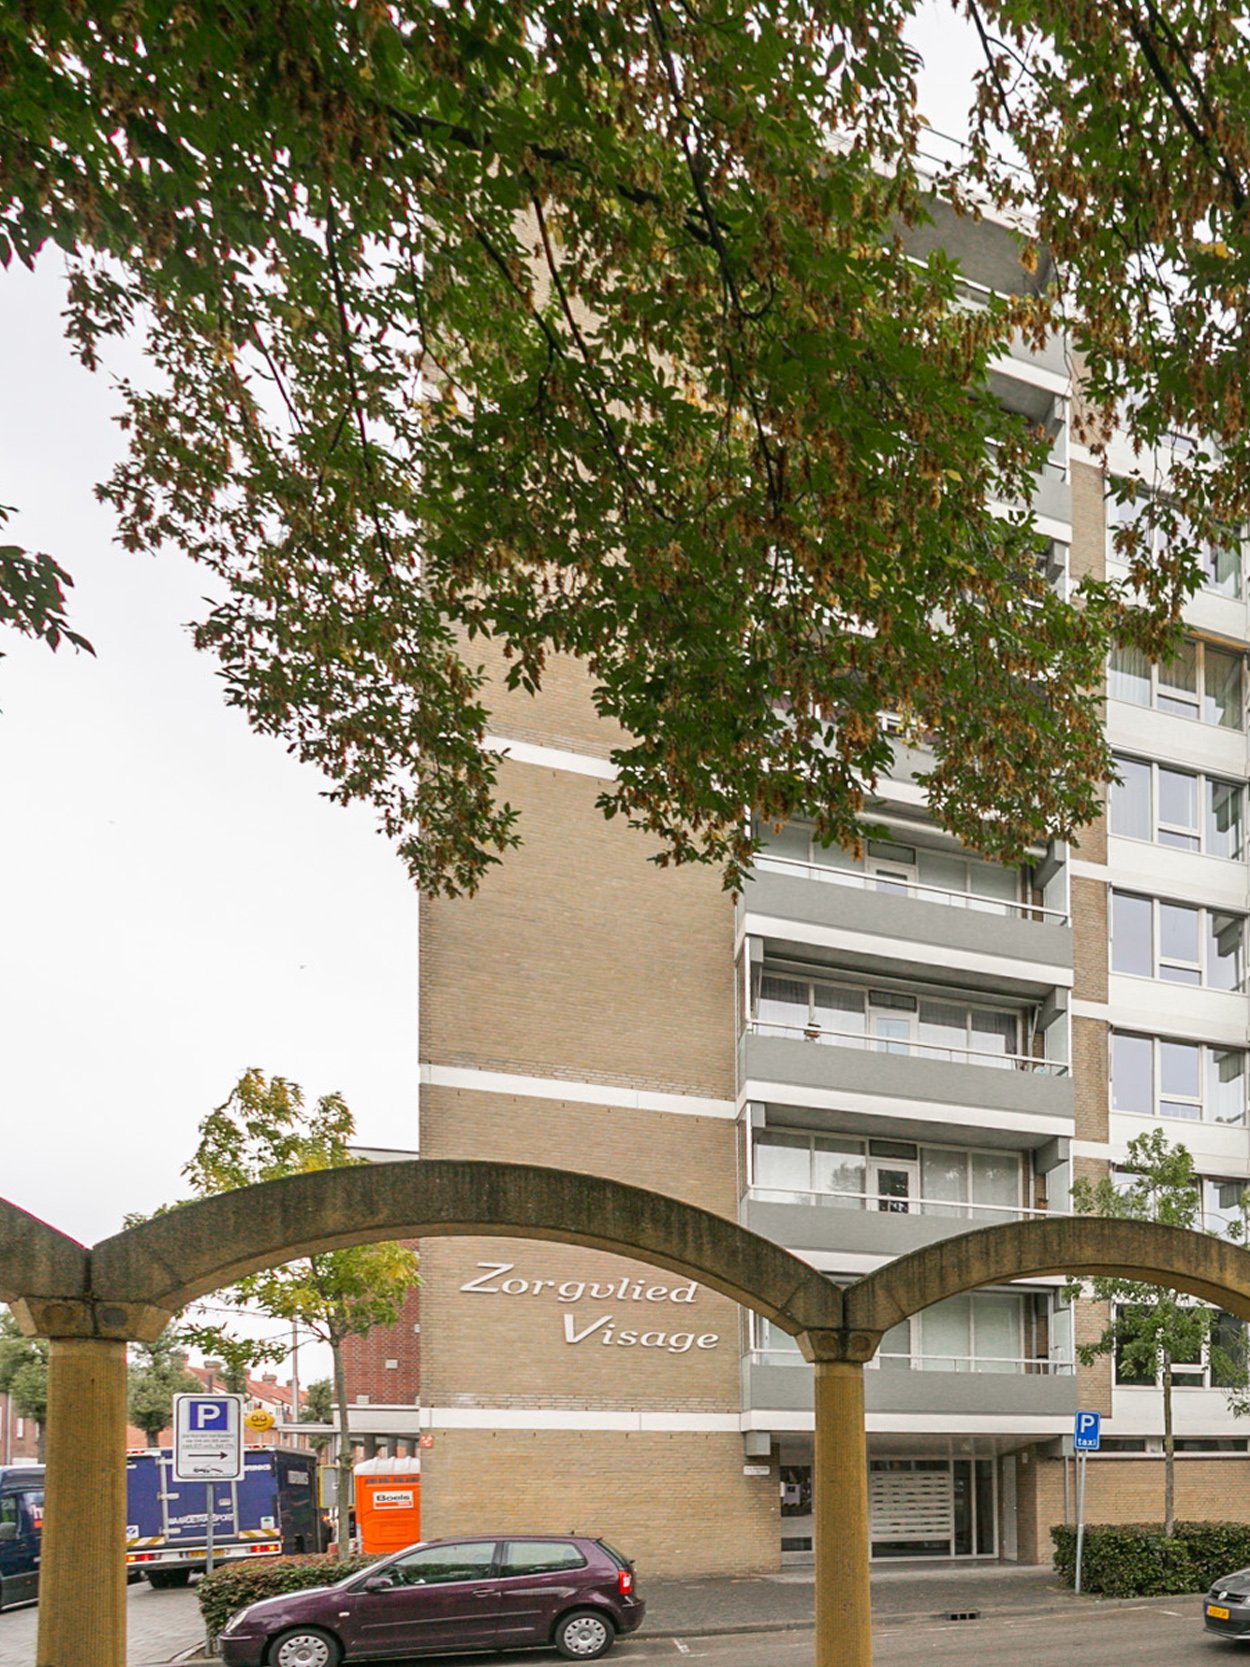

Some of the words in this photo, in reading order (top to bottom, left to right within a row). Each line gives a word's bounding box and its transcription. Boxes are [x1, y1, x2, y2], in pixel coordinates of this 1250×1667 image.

[459, 1262, 698, 1303] Zorgvlied
[564, 1313, 719, 1352] Visage
[197, 1404, 220, 1428] P
[1081, 1415, 1095, 1433] P
[1078, 1438, 1097, 1446] taxi
